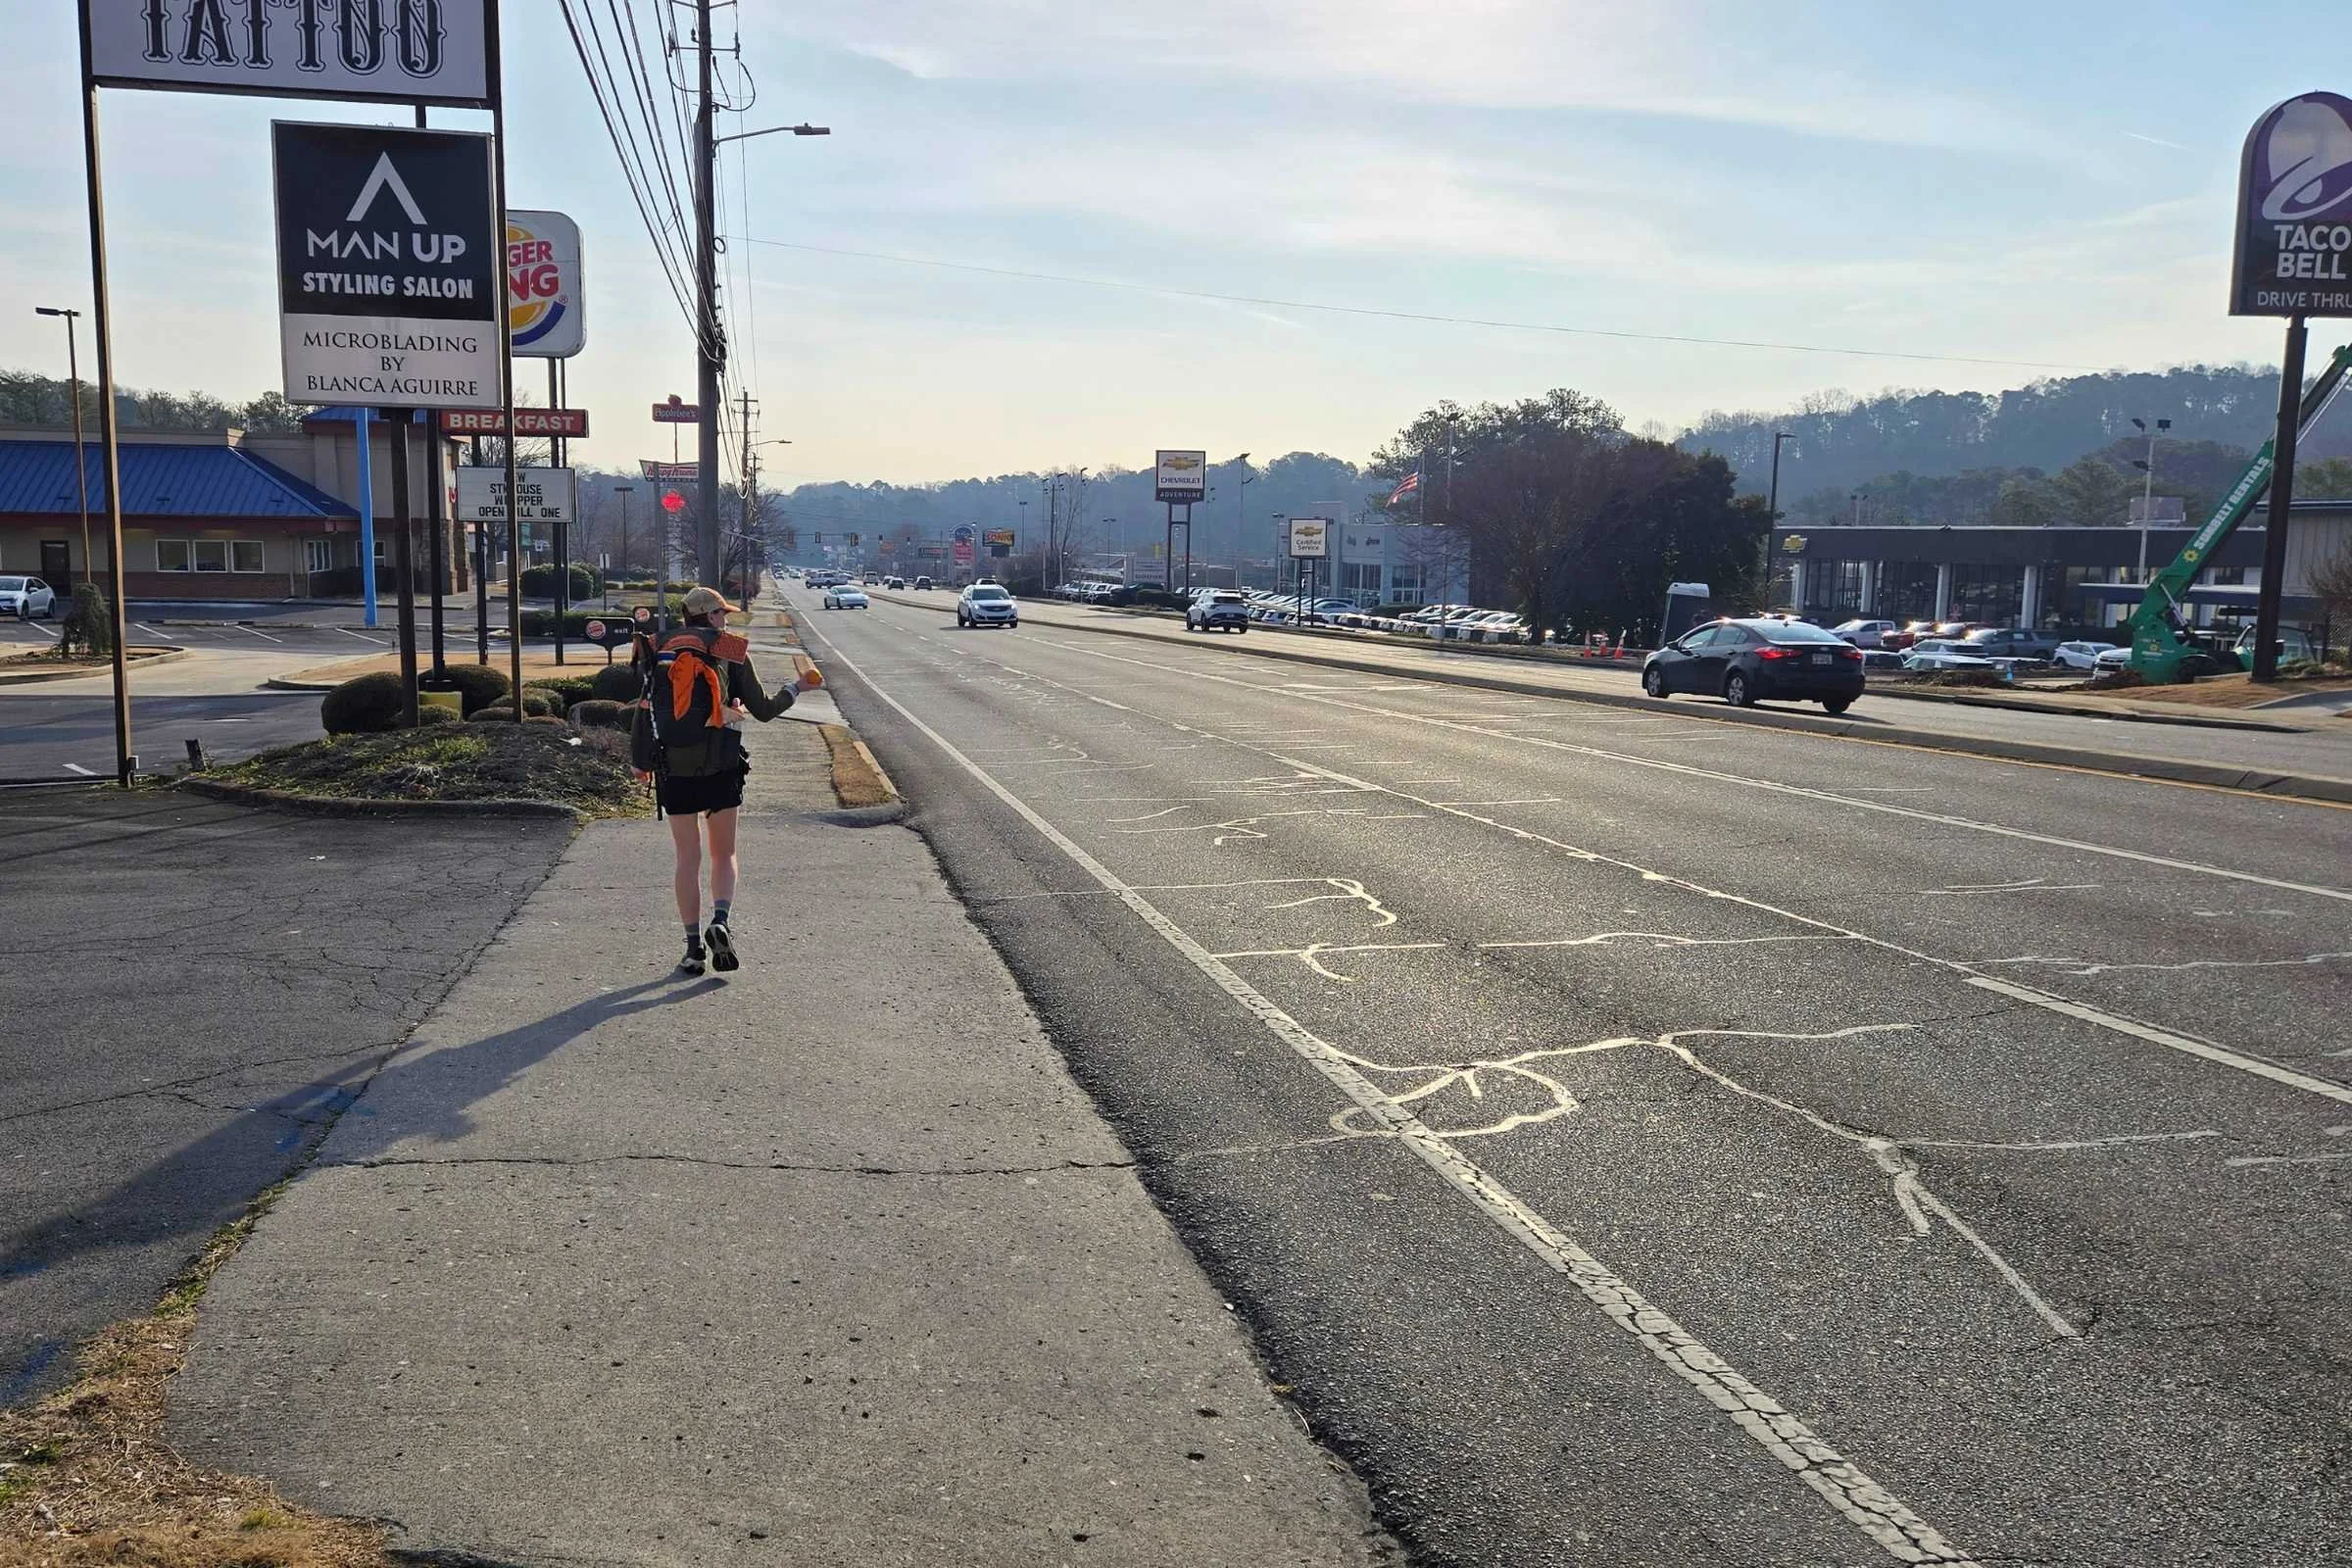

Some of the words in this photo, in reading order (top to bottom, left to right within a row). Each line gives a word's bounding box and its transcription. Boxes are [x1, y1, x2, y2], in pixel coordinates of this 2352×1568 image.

[140, 0, 448, 78] TATTOO
[307, 228, 400, 260] MAN
[412, 232, 466, 264] UP
[2274, 224, 2351, 251] TACO
[508, 240, 554, 268] GER
[2277, 252, 2347, 279] BELL
[303, 272, 395, 296] STYLING
[403, 276, 473, 299] SALON
[509, 264, 560, 301] NG
[2257, 291, 2307, 307] DRIVE
[303, 331, 477, 353] MICROBLADING
[380, 356, 406, 371] BY
[307, 375, 386, 393] BLANCA
[391, 379, 478, 396] AGUIRRE
[449, 414, 574, 431] BREAKFAST
[490, 483, 542, 494] STOUSE
[494, 495, 543, 506] WPPER
[478, 507, 505, 517] OPEN
[516, 508, 533, 517] ILL
[541, 508, 561, 517] ONE
[2193, 502, 2234, 550] SUNBELT
[2228, 457, 2271, 505] RENTALS
